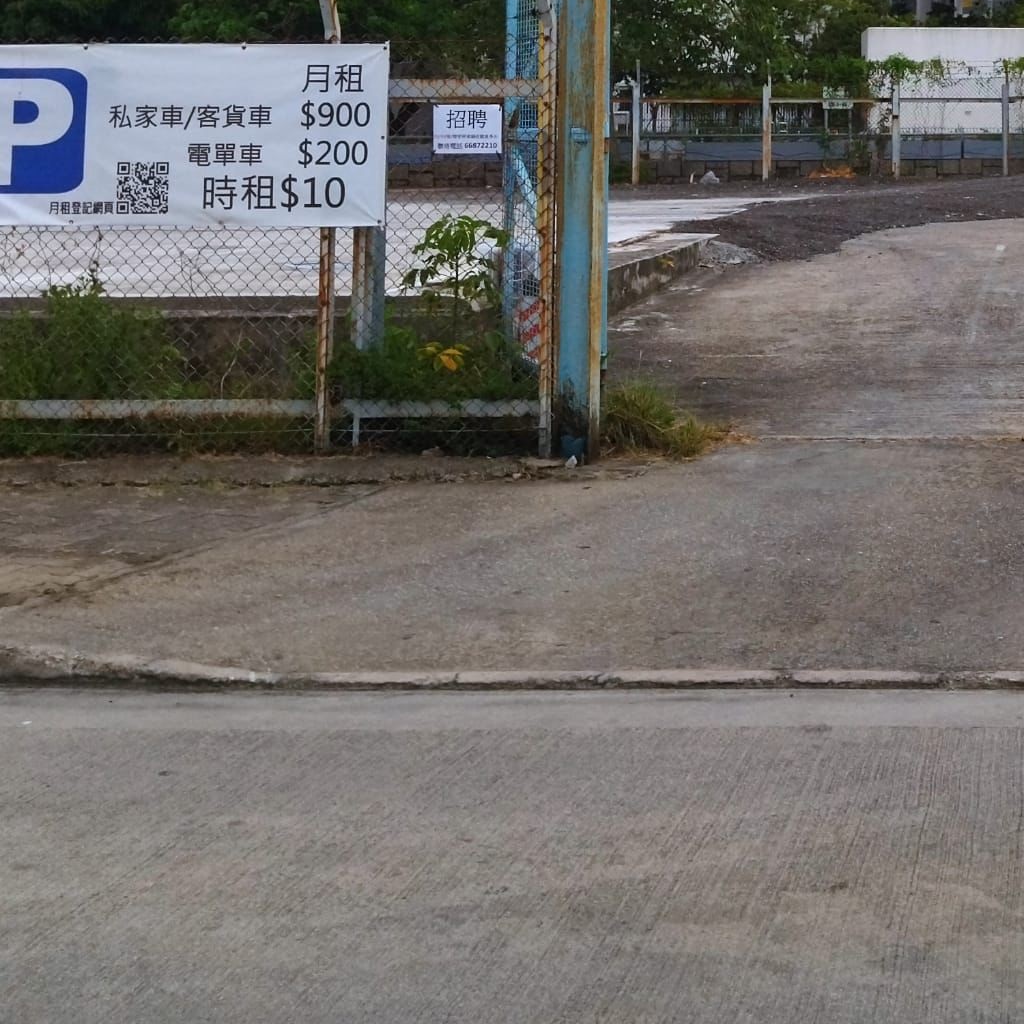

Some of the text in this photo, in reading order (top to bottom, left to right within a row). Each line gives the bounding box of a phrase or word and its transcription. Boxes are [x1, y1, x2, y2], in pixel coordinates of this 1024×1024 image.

[301, 63, 364, 93] 月租
[108, 99, 371, 130] 私家車/客貨車 $900
[446, 109, 488, 129] 招聘
[187, 139, 368, 168] 電單車 $200
[49, 201, 114, 215] 月租登記網頁
